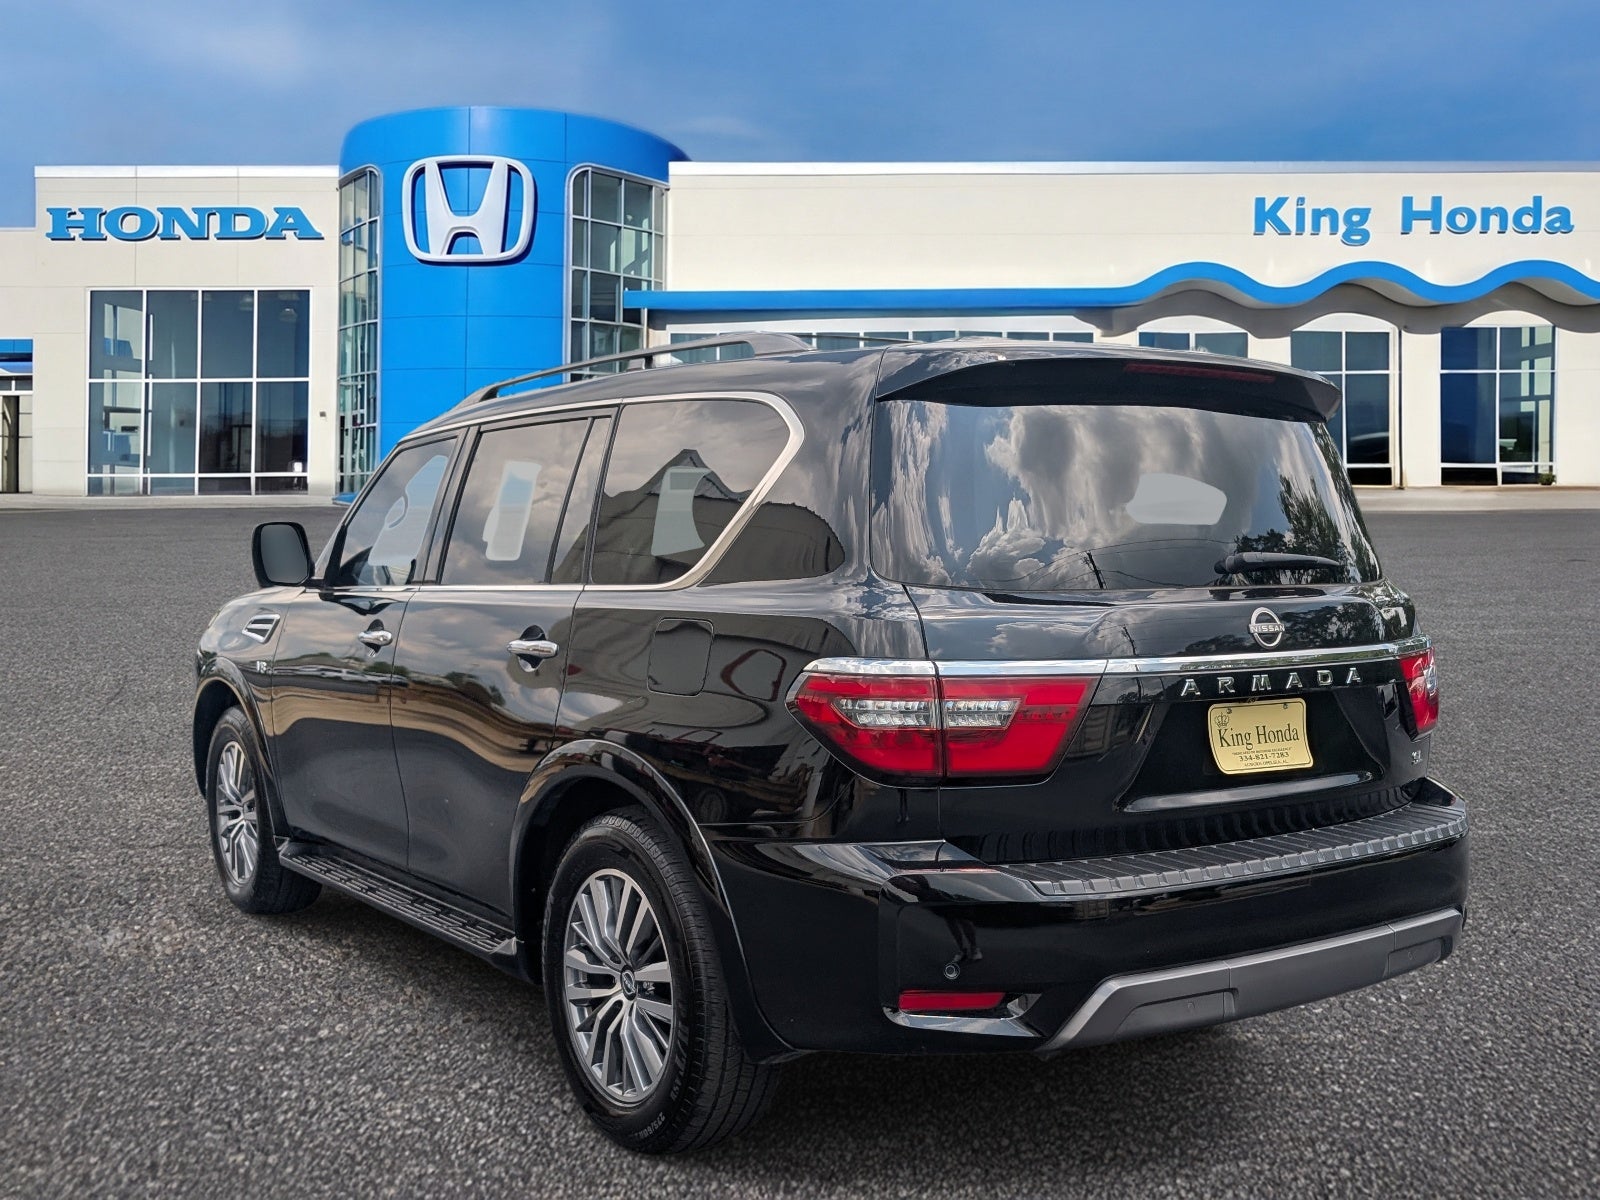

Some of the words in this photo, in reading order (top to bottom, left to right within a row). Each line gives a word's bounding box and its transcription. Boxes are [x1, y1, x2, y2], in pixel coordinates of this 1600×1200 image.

[46, 207, 323, 240] HONDA
[1253, 196, 1371, 247] King
[1401, 195, 1574, 234] Honda
[1250, 623, 1285, 633] NISSAN
[1181, 667, 1362, 696] ARMADA
[1217, 728, 1253, 750] King
[1255, 723, 1299, 744] Honda
[1239, 751, 1289, 762] 334-821-7283
